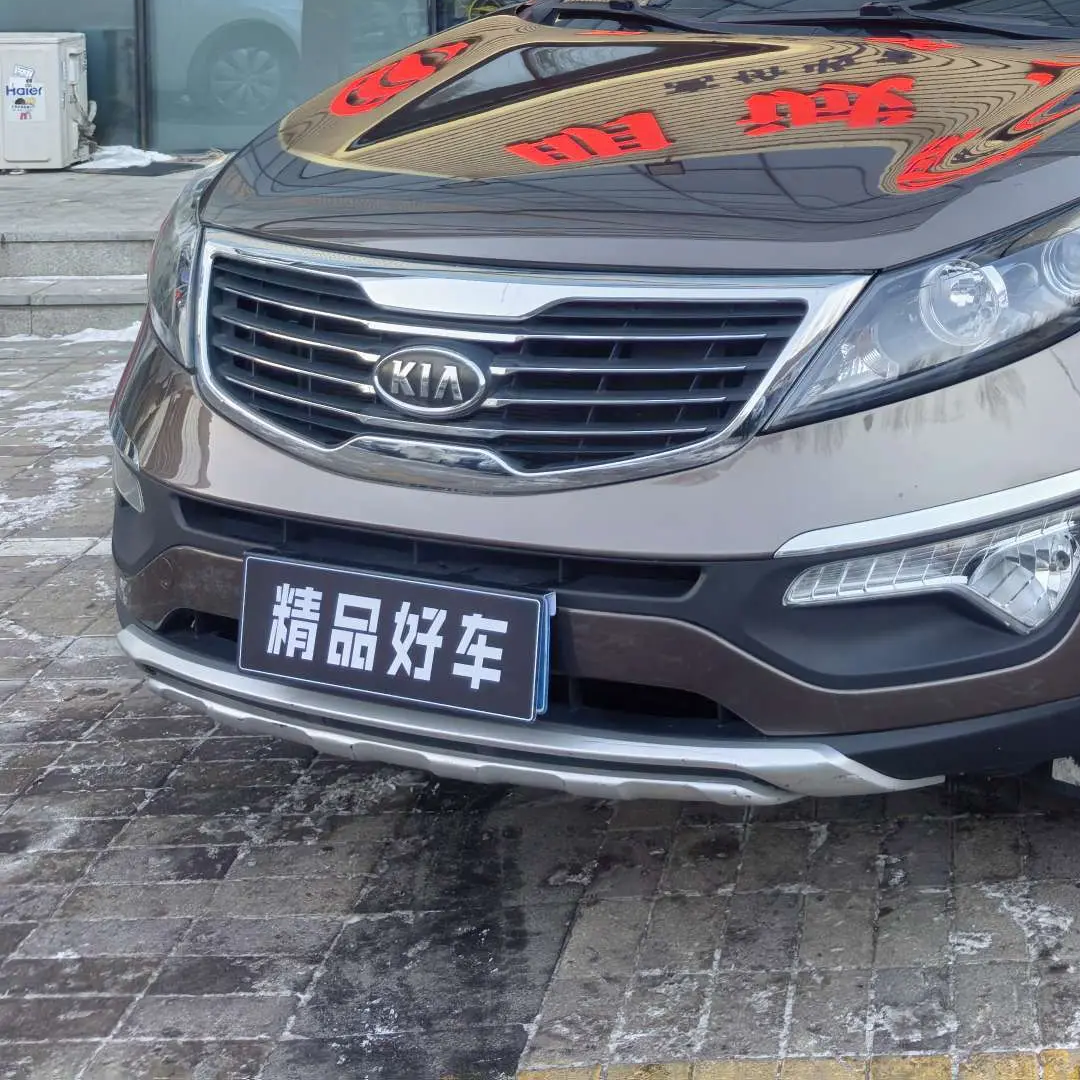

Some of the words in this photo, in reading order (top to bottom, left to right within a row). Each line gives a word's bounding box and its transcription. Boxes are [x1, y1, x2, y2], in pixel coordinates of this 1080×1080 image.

[6, 84, 43, 96] Haier
[390, 360, 463, 401] KIA
[266, 582, 509, 690] 精品好车
